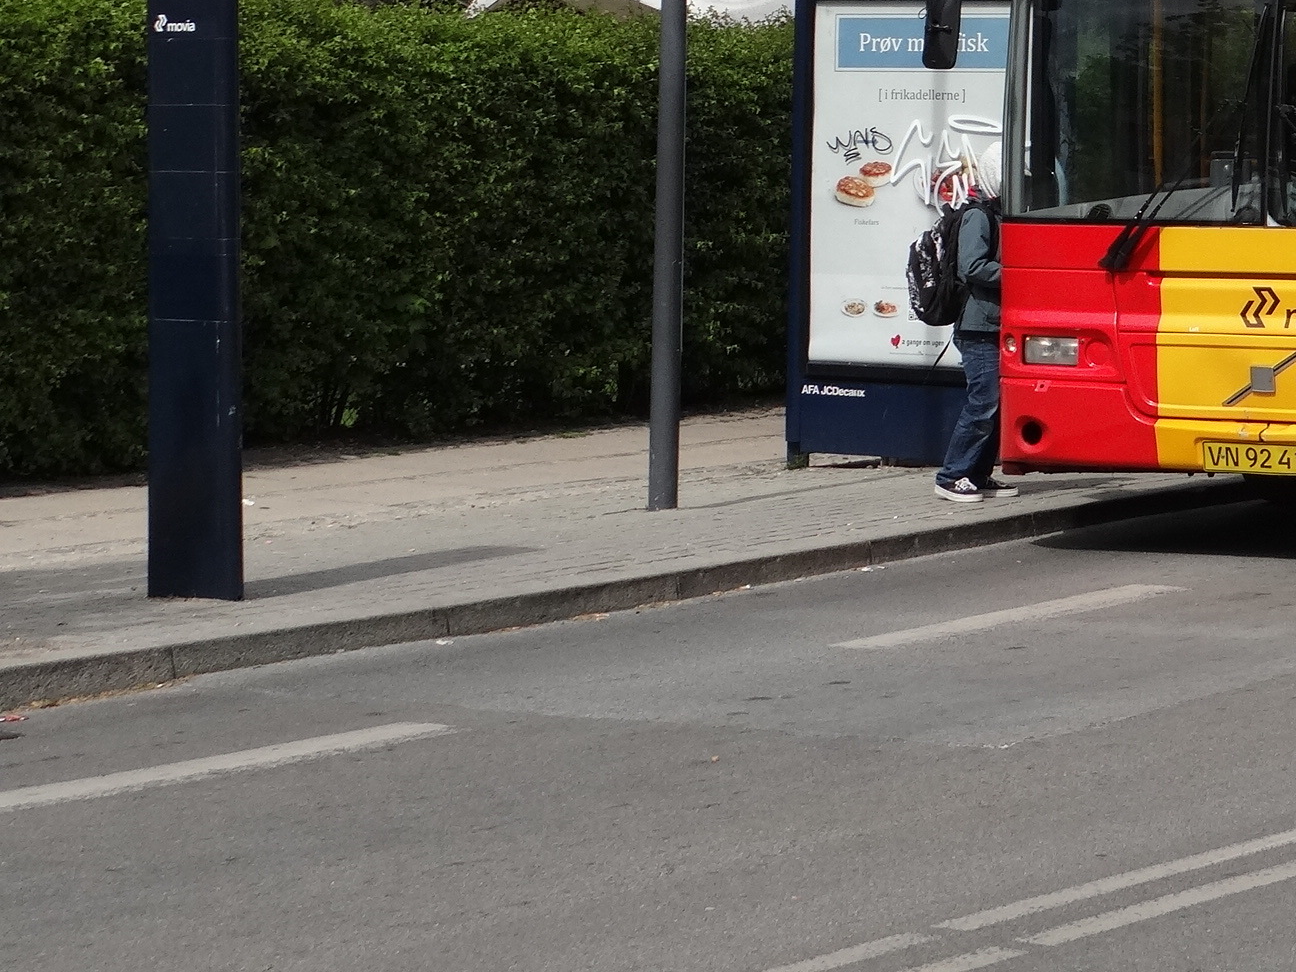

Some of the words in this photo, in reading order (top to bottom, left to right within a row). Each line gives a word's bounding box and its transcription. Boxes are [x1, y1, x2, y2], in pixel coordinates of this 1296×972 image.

[166, 19, 196, 32] movia
[859, 32, 903, 54] Prøv
[884, 89, 889, 100] i
[891, 88, 960, 101] frikadellerne
[906, 339, 922, 347] gange
[931, 340, 945, 348] ugen
[801, 384, 820, 395] AFA
[820, 385, 866, 398] JCDecaux
[1207, 446, 1240, 467] VN
[1245, 446, 1273, 469] 92
